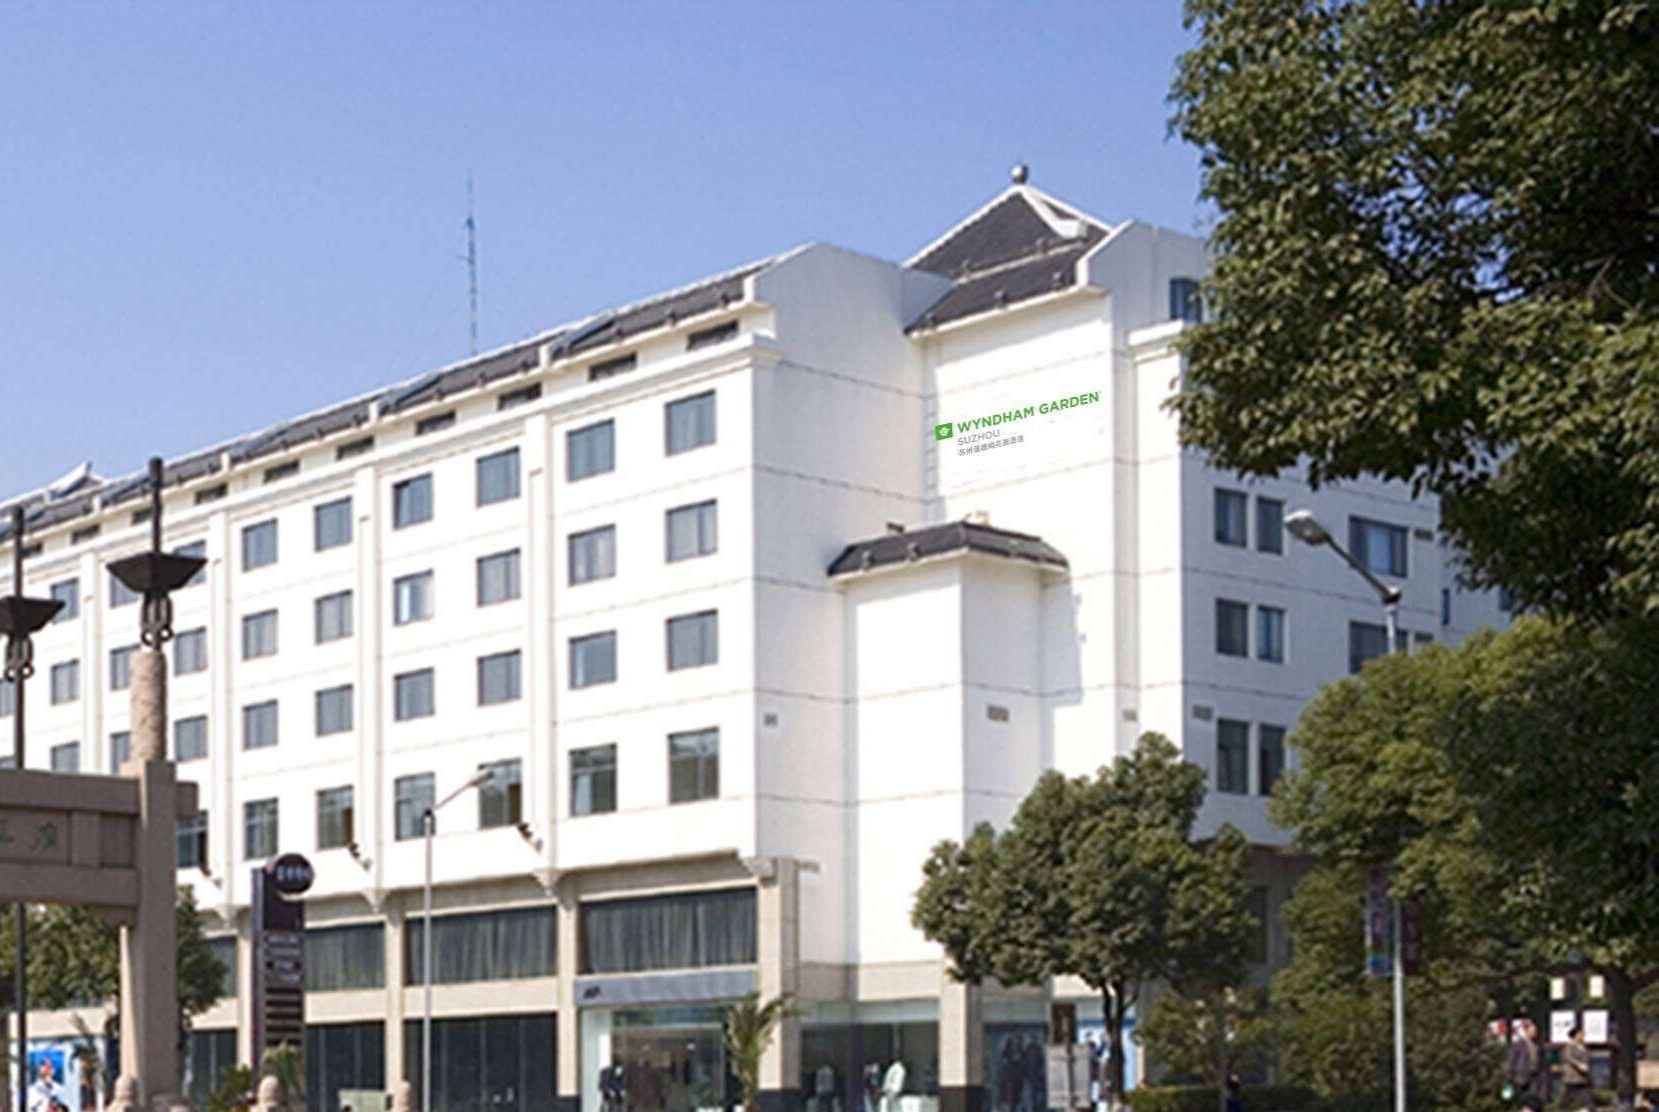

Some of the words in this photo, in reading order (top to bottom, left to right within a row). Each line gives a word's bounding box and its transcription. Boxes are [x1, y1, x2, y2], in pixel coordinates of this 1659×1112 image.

[957, 406, 1035, 433] WYNDHAM
[1038, 391, 1100, 414] GARDEN
[957, 429, 1000, 446] SUZHOU
